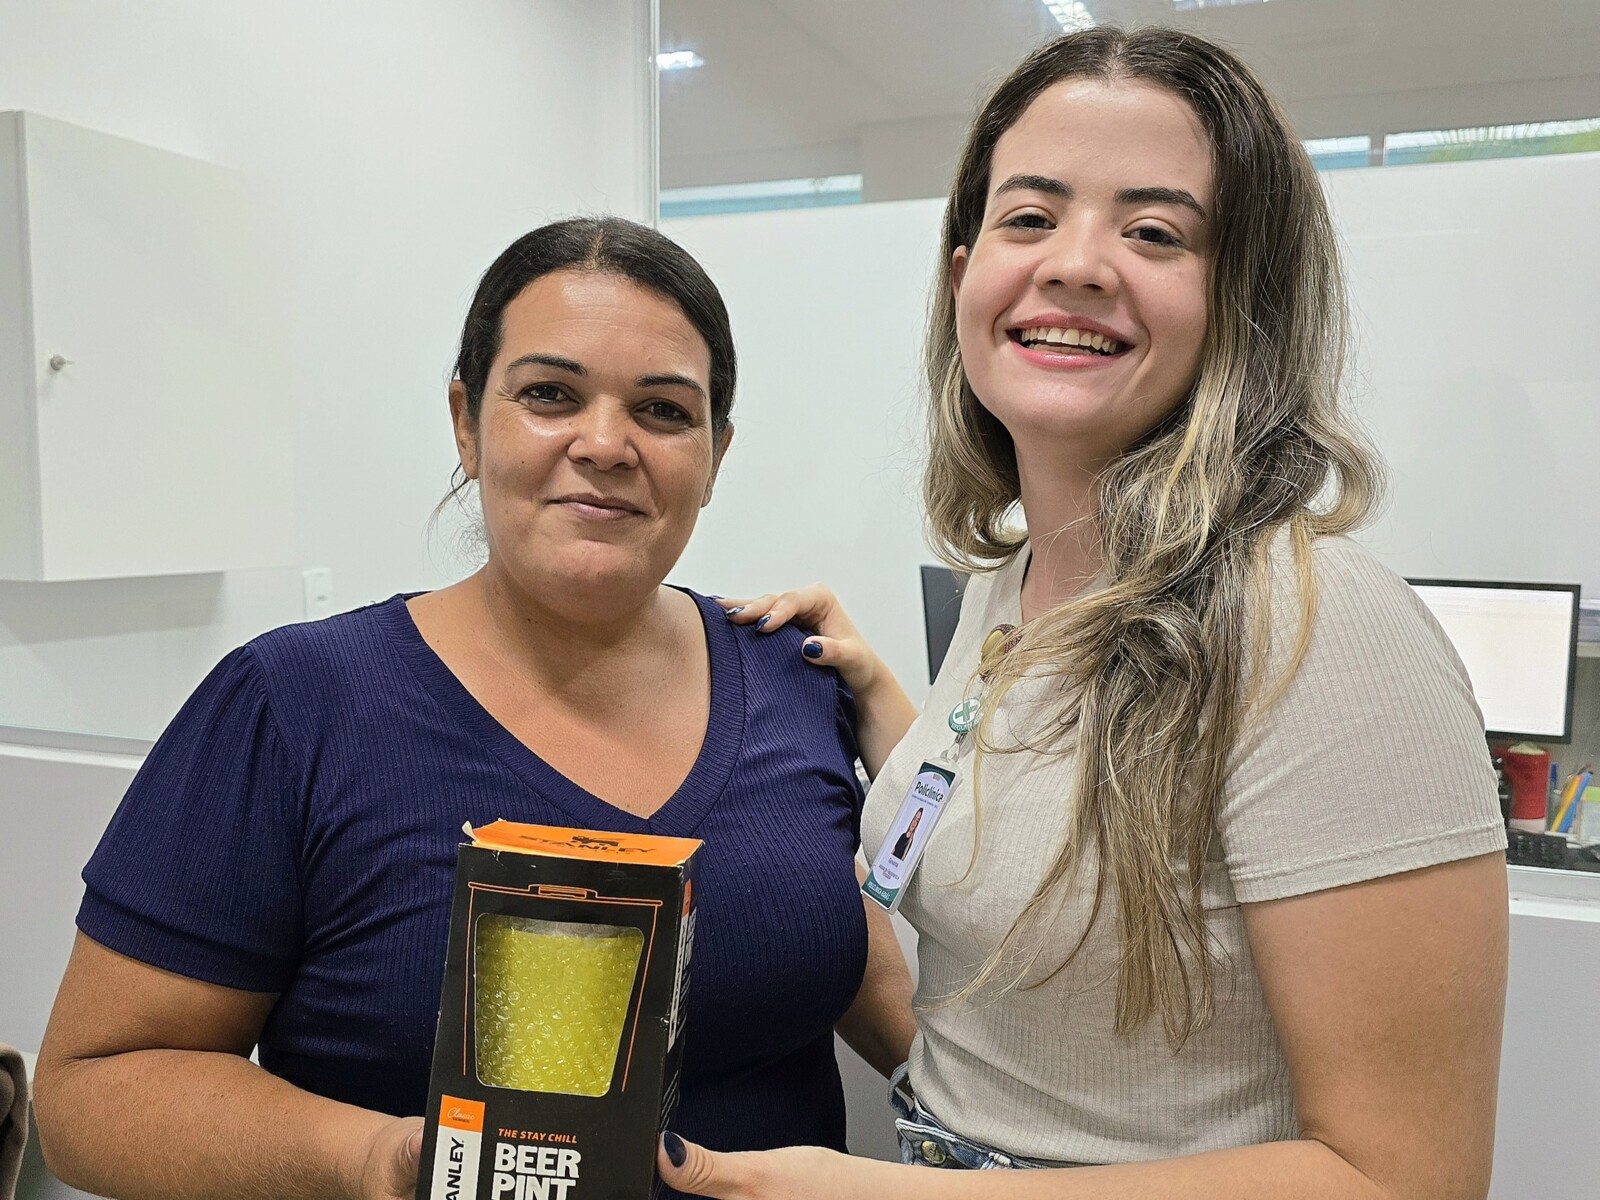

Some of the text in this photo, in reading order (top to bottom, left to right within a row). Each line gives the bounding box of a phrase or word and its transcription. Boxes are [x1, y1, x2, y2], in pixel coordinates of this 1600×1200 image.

[498, 1128, 578, 1144] THE STAY CHILL
[494, 1142, 582, 1179] BEER
[491, 1171, 577, 1200] PINT
